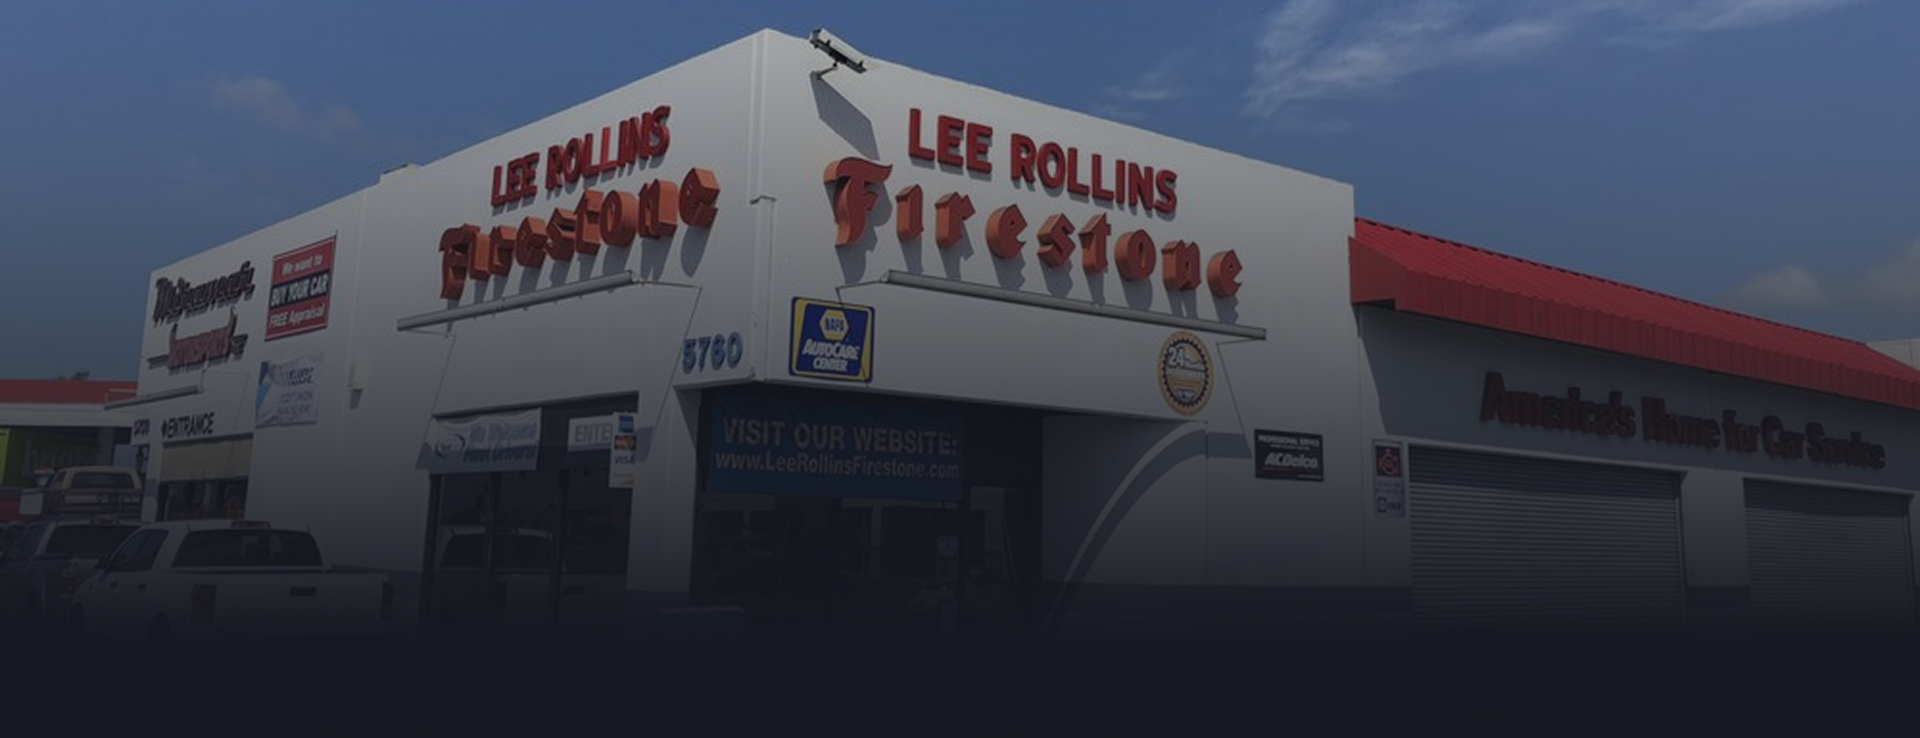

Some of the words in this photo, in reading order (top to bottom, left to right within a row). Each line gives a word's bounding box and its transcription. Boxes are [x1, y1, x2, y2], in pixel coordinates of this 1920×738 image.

[491, 151, 540, 207] LEE
[545, 103, 672, 191] ROLLINS
[908, 106, 994, 173] LEE
[1010, 132, 1178, 214] ROLLINS
[438, 167, 721, 299] Firestone
[822, 156, 1243, 299] Firestone
[271, 285, 288, 306] BUY
[288, 278, 310, 301] YOUR
[311, 272, 328, 295] CAR
[270, 311, 288, 328] FREE
[289, 303, 325, 326] Appraisal
[682, 330, 744, 375] 5760
[813, 358, 848, 372] CENTER
[167, 411, 215, 438] ENTRANCE
[574, 422, 613, 443] ENTE
[723, 416, 785, 447] VISIT
[793, 422, 845, 451] OUR
[852, 425, 958, 456] WEBSITE:
[1479, 371, 1637, 437] America's
[1641, 395, 1721, 449] Home
[1722, 409, 1760, 453] for
[1761, 414, 1804, 459] Car
[1805, 421, 1886, 469] Service
[614, 454, 635, 465] VISA
[714, 449, 959, 479] www.LeeRollinsFirestone.com
[1264, 451, 1319, 469] ACDelco
